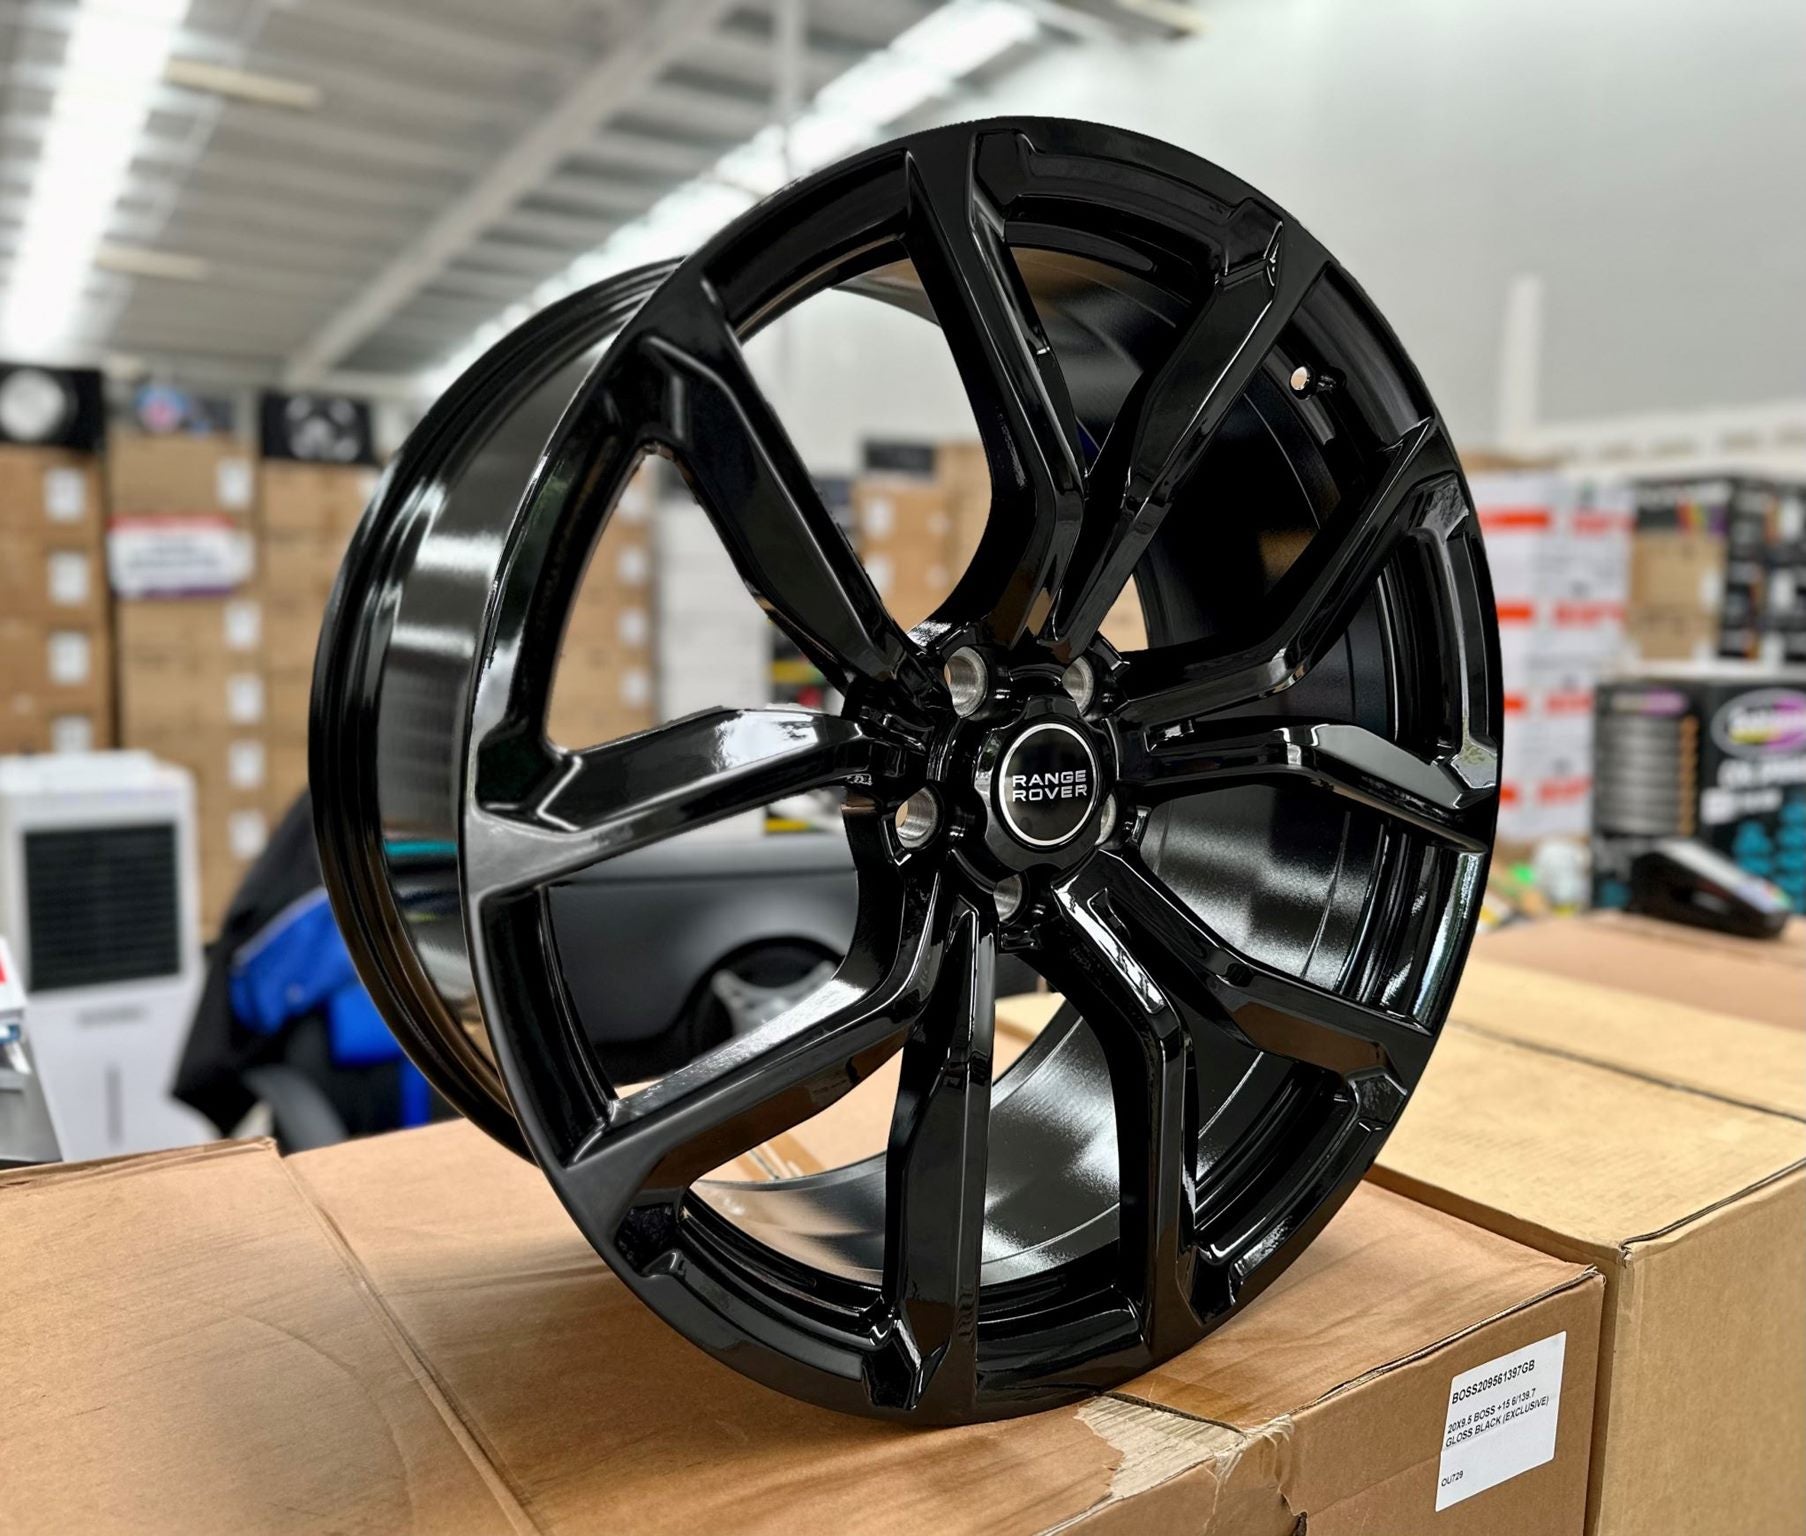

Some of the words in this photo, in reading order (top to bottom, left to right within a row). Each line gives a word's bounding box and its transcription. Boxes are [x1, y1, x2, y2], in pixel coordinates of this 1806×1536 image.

[1012, 770, 1087, 787] RANGE
[1012, 784, 1088, 802] ROVER
[1451, 1359, 1536, 1405] BOSS209561397GB
[1445, 1428, 1473, 1448] GLOSS
[1474, 1415, 1502, 1435] BLACK
[1502, 1396, 1550, 1424] (EXCLUSIVE)
[1447, 1415, 1473, 1435] 20X9.5
[1473, 1405, 1496, 1423] BOSS
[1497, 1399, 1511, 1411] +15
[1511, 1388, 1537, 1406] 6/139.7
